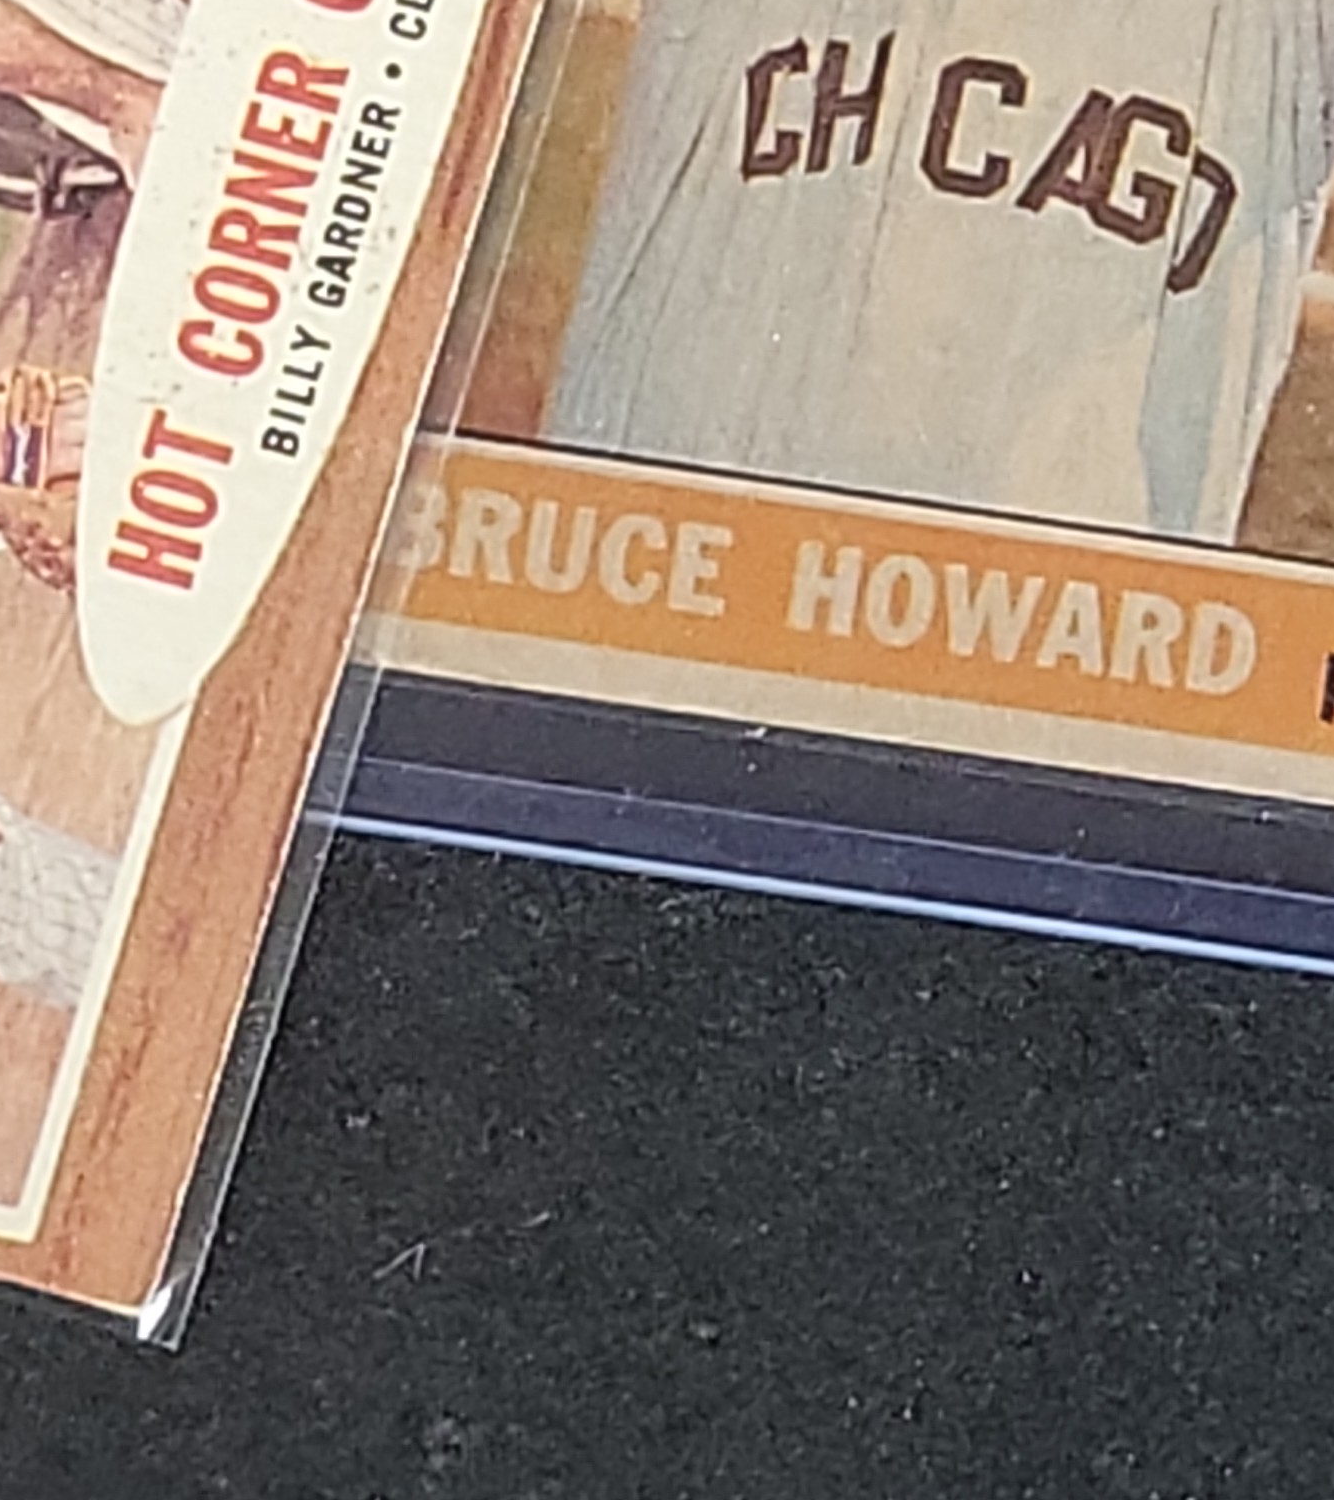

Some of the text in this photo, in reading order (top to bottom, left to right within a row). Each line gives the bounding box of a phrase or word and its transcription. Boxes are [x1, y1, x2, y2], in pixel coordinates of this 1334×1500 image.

[107, 408, 235, 591] HOT
[176, 50, 351, 378] CORNER
[261, 325, 332, 458] BILLY
[307, 100, 402, 309] GARDNER
[400, 480, 734, 618] BRUCE
[785, 539, 1258, 696] HOWARD
